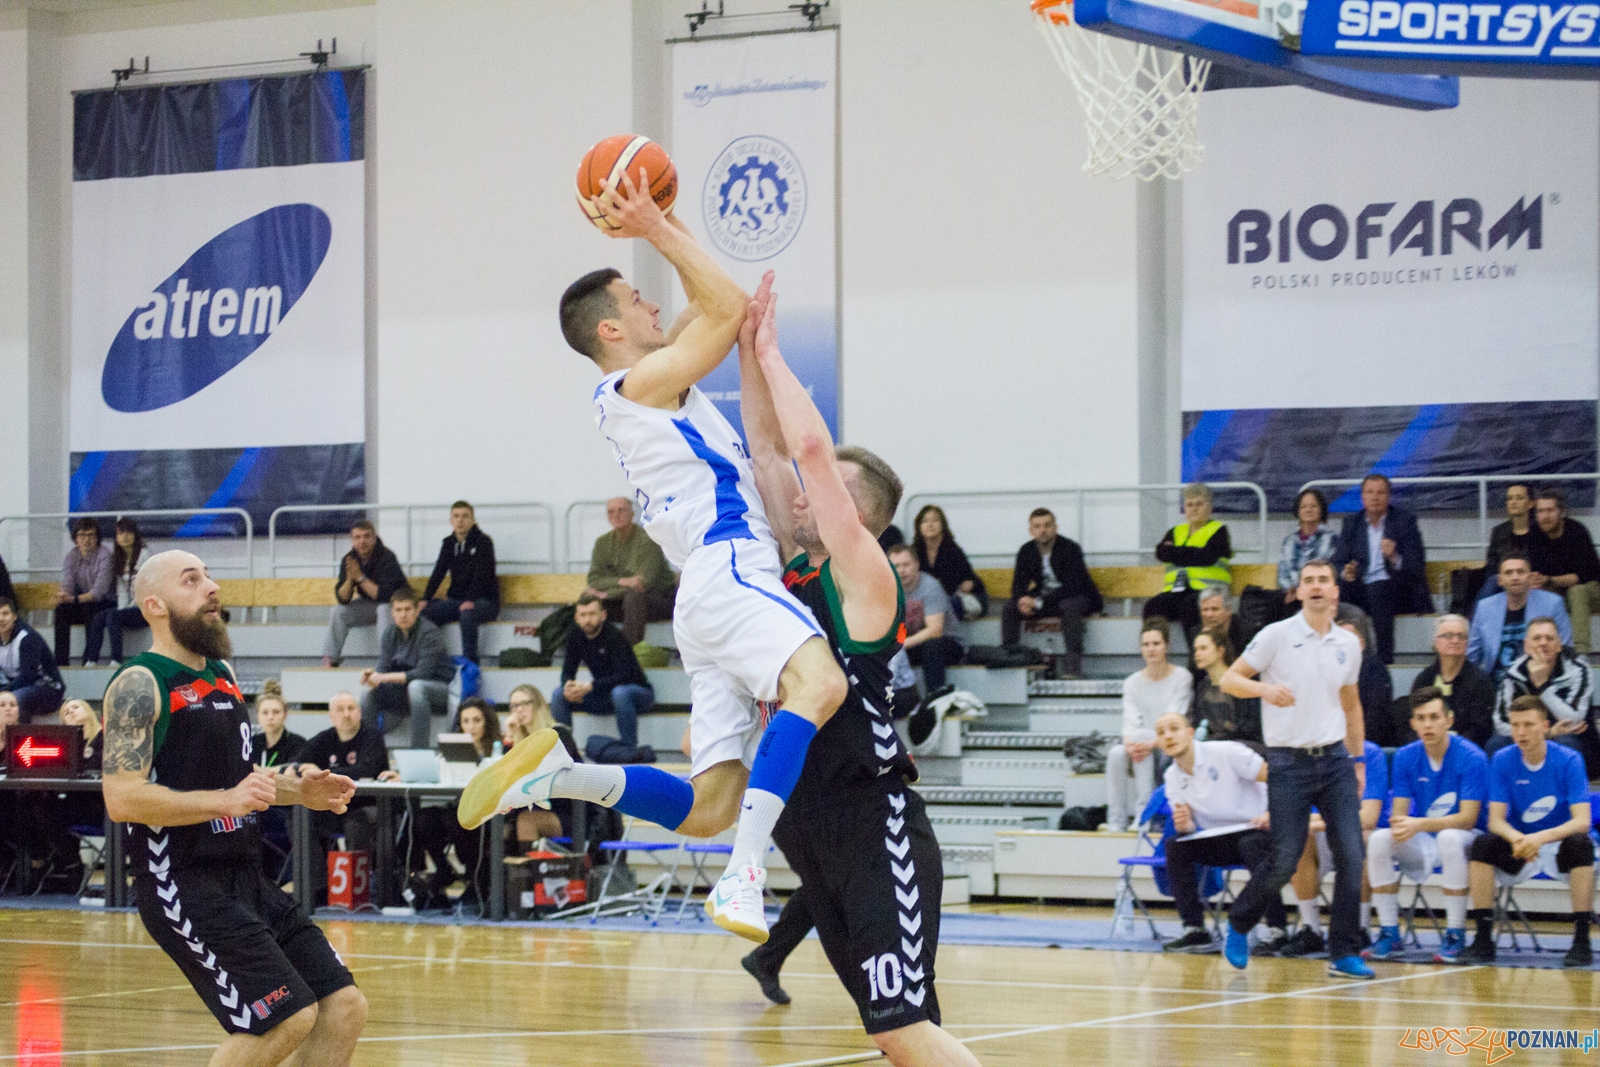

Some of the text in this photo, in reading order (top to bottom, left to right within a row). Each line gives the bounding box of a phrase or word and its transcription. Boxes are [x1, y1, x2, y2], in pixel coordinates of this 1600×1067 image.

[1338, 1, 1600, 44] SPORTSYS
[1227, 193, 1543, 264] BIOFARM
[1251, 261, 1518, 290] POLSKI PRODUCENT LEKÓW
[133, 278, 283, 341] atrem
[331, 856, 349, 895] 5
[353, 856, 368, 895] 5
[860, 952, 903, 1001] 10
